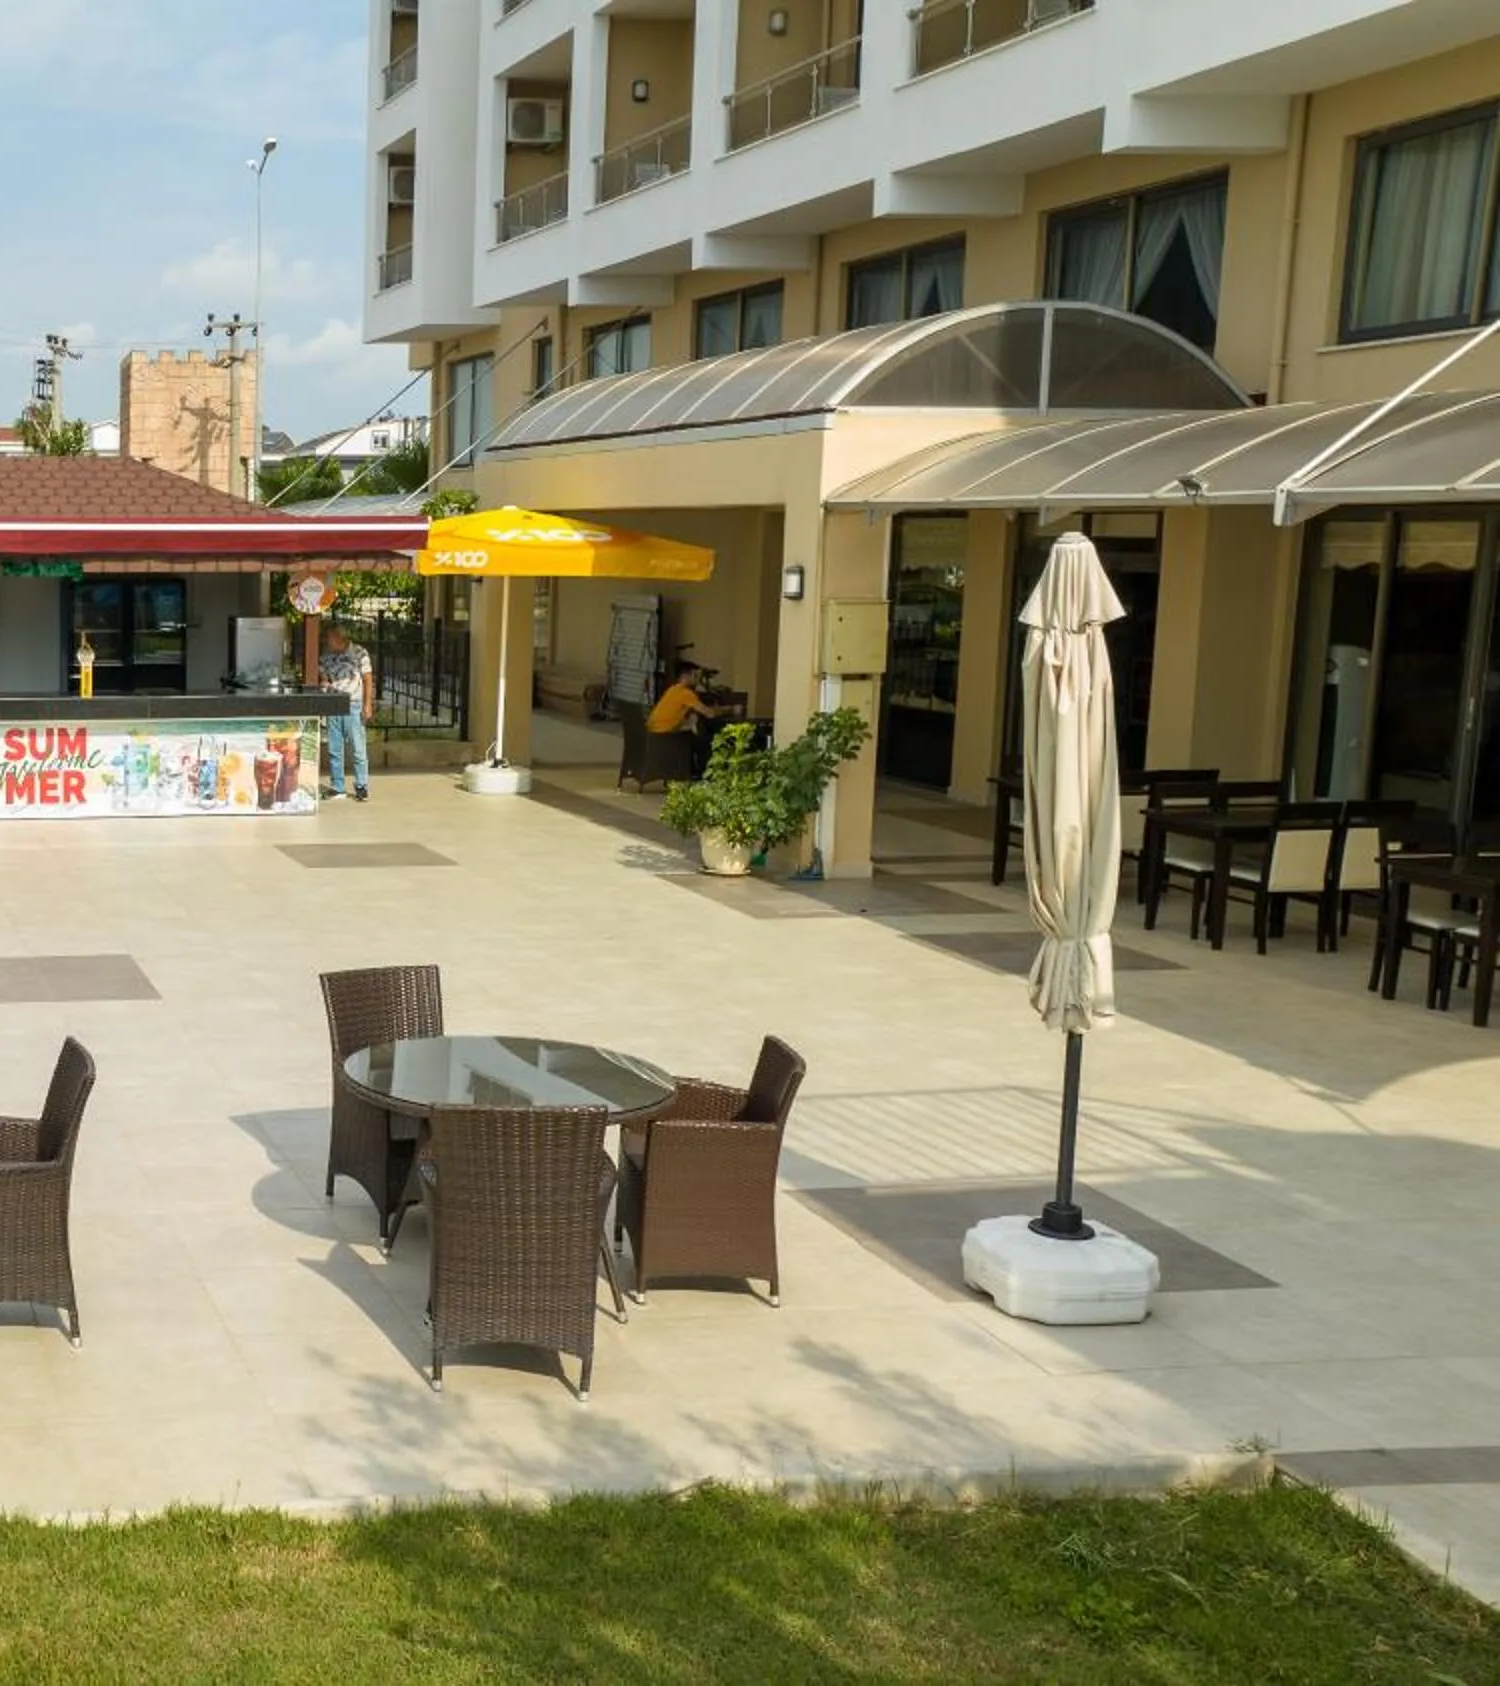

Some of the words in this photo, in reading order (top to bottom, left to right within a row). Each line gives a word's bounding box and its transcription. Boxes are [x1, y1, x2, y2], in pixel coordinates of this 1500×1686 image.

[433, 550, 488, 568] %100
[4, 727, 88, 761] SUM
[5, 771, 87, 805] MER
